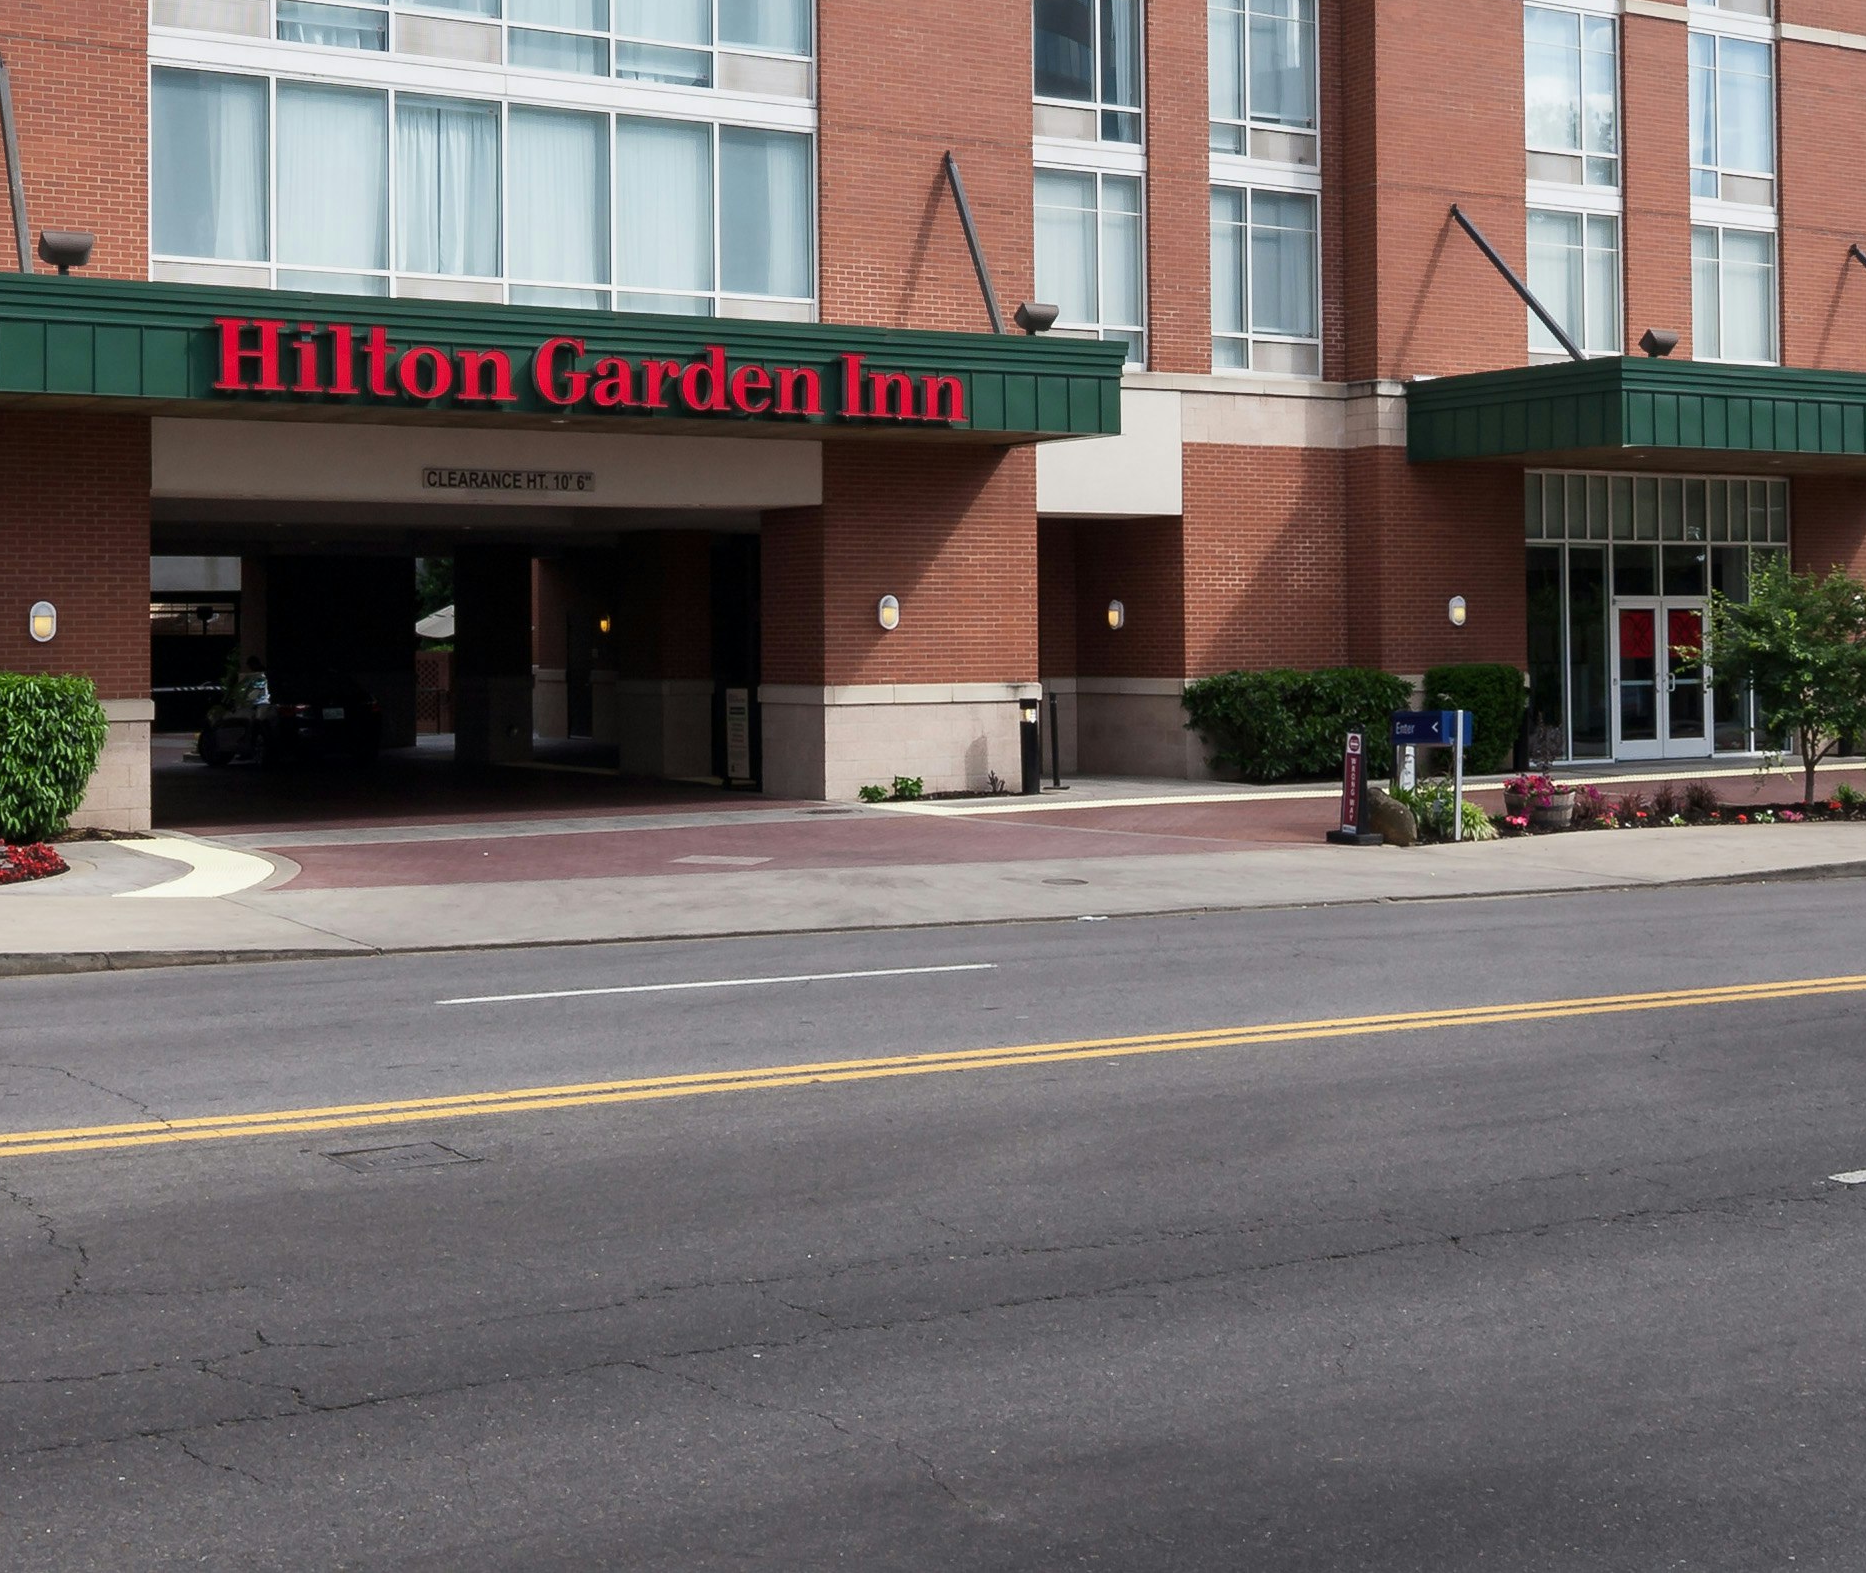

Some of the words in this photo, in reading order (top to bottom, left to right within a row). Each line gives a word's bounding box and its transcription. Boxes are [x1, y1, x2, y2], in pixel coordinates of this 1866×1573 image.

[213, 316, 518, 402] Hilton
[534, 336, 825, 415] Garden
[839, 351, 968, 423] Inn
[427, 471, 522, 489] CLEARANCE
[527, 474, 549, 489] HT.
[553, 474, 573, 490] 10'
[576, 474, 592, 490] 6"
[1395, 721, 1415, 735] Enter
